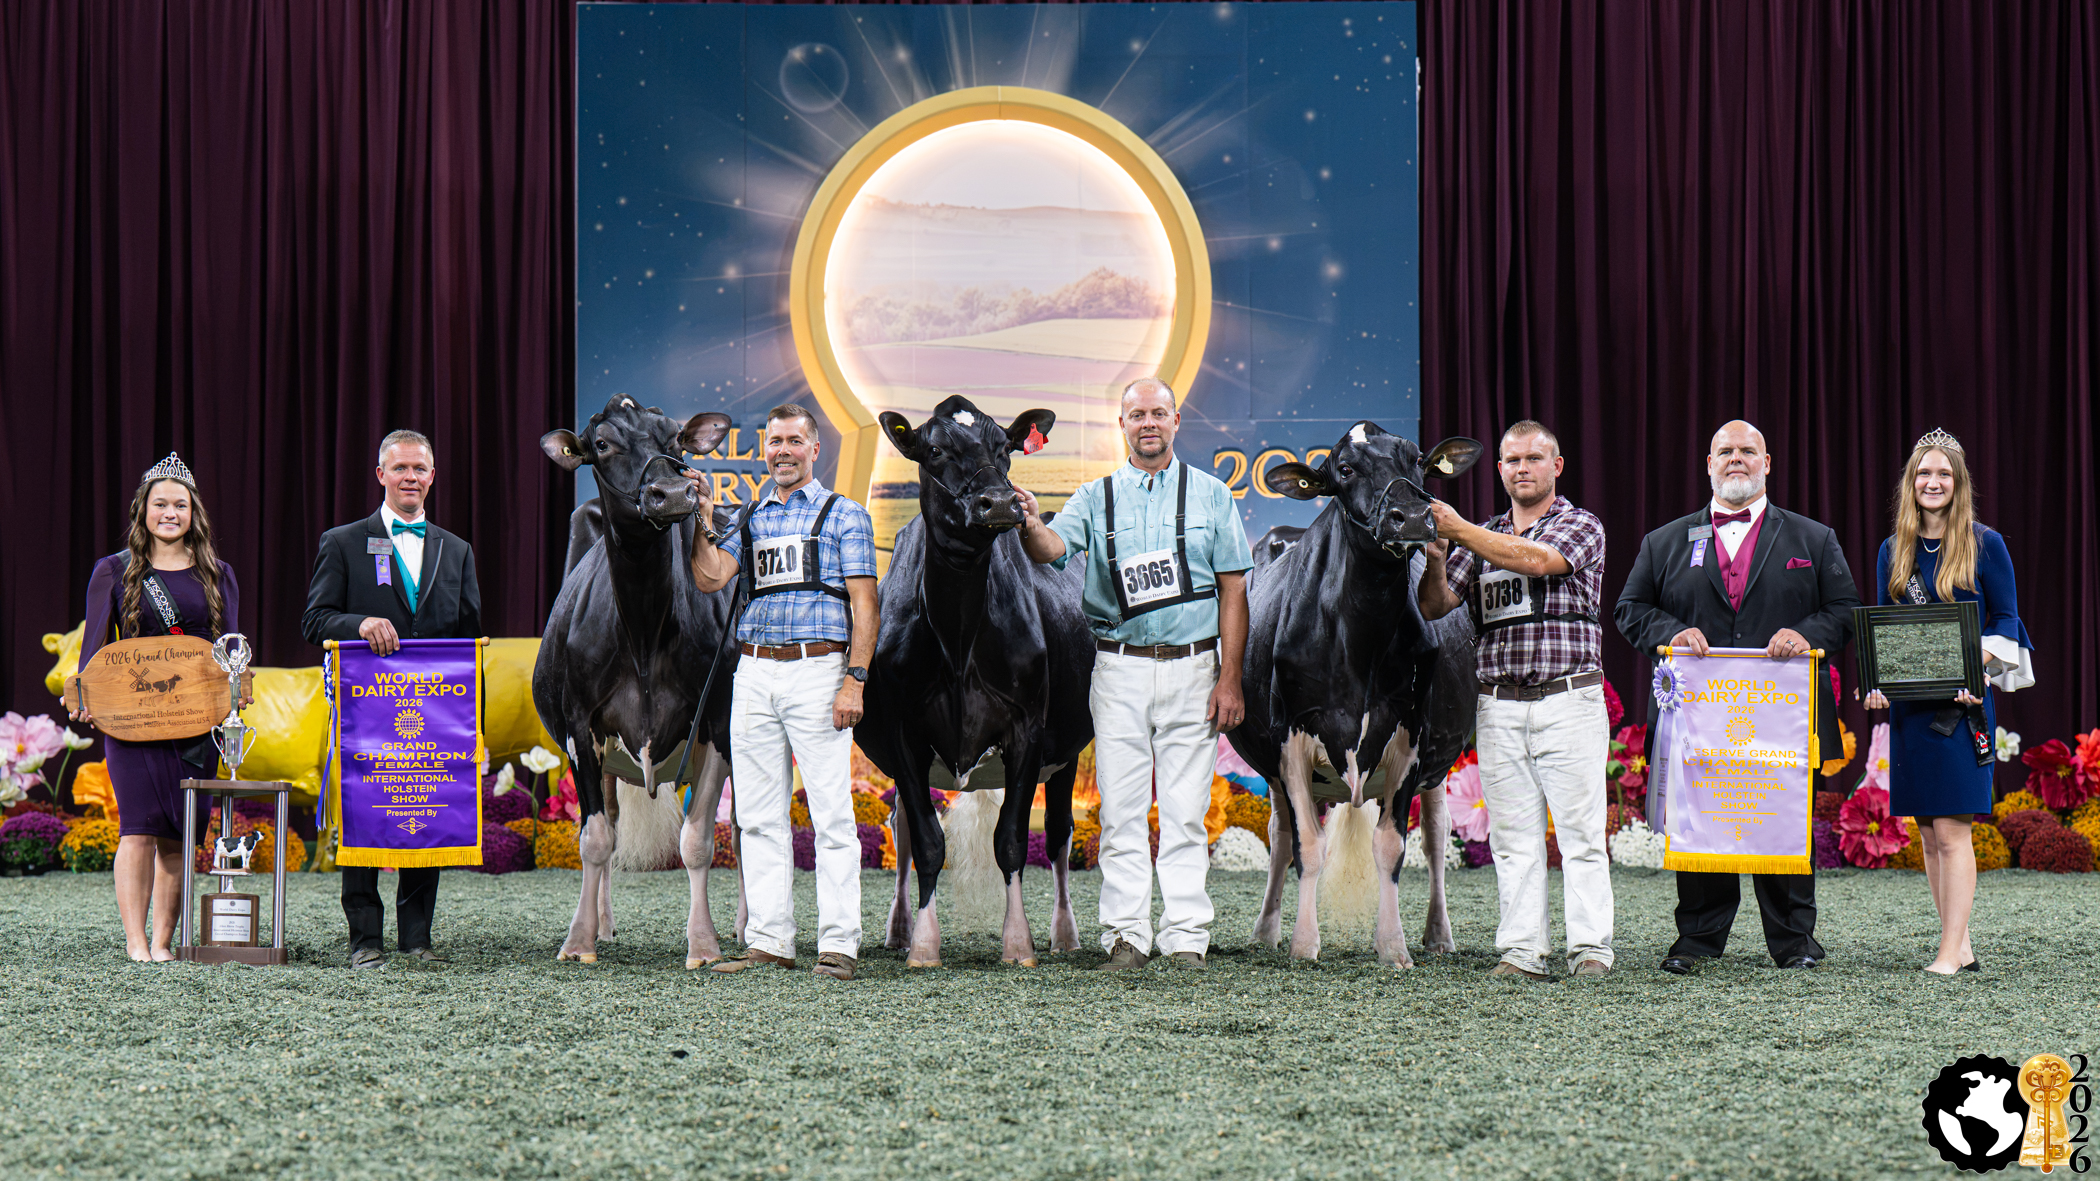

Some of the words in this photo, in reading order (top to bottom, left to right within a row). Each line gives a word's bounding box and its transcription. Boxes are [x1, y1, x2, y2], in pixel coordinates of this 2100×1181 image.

[758, 544, 797, 578] 3720
[1124, 558, 1175, 595] 3665
[1484, 577, 1523, 611] 3738
[148, 575, 179, 625] WISCONSIN
[104, 651, 131, 665] 2026
[132, 648, 162, 665] Grand
[164, 647, 204, 661] Champion
[374, 672, 444, 684] WORLD
[1706, 679, 1777, 691] WORLD
[351, 684, 409, 698] DAIRY
[414, 684, 467, 697] EXPO
[394, 698, 423, 707] 2026
[1683, 690, 1742, 704] DAIRY
[1747, 691, 1800, 705] EXPO
[113, 710, 156, 721] International
[157, 708, 185, 718] Holstein
[185, 707, 205, 716] Show
[1726, 704, 1756, 714] 2026
[110, 721, 136, 731] Sponsored
[136, 721, 143, 729] by
[166, 718, 196, 727] Association
[196, 716, 211, 724] USA
[381, 741, 437, 750] GRAND
[353, 751, 467, 761] CHAMPION
[1693, 748, 1745, 758] ESERVE
[1749, 749, 1797, 759] GRAND
[375, 761, 445, 769] FEMALE
[1684, 758, 1798, 769] CHAMPION
[1705, 768, 1776, 776] FEMALE
[362, 774, 457, 783] INTERNATIONAL
[383, 784, 437, 793] HOLSTEIN
[1691, 780, 1788, 791] INTERNATIONAL
[391, 794, 429, 803] SHOW
[1712, 791, 1767, 801] HOLSTEIN
[1720, 801, 1759, 810] SHOW
[386, 809, 425, 817] Presented
[426, 808, 438, 818] By
[1712, 815, 1752, 824] Presented
[1753, 816, 1764, 826] By
